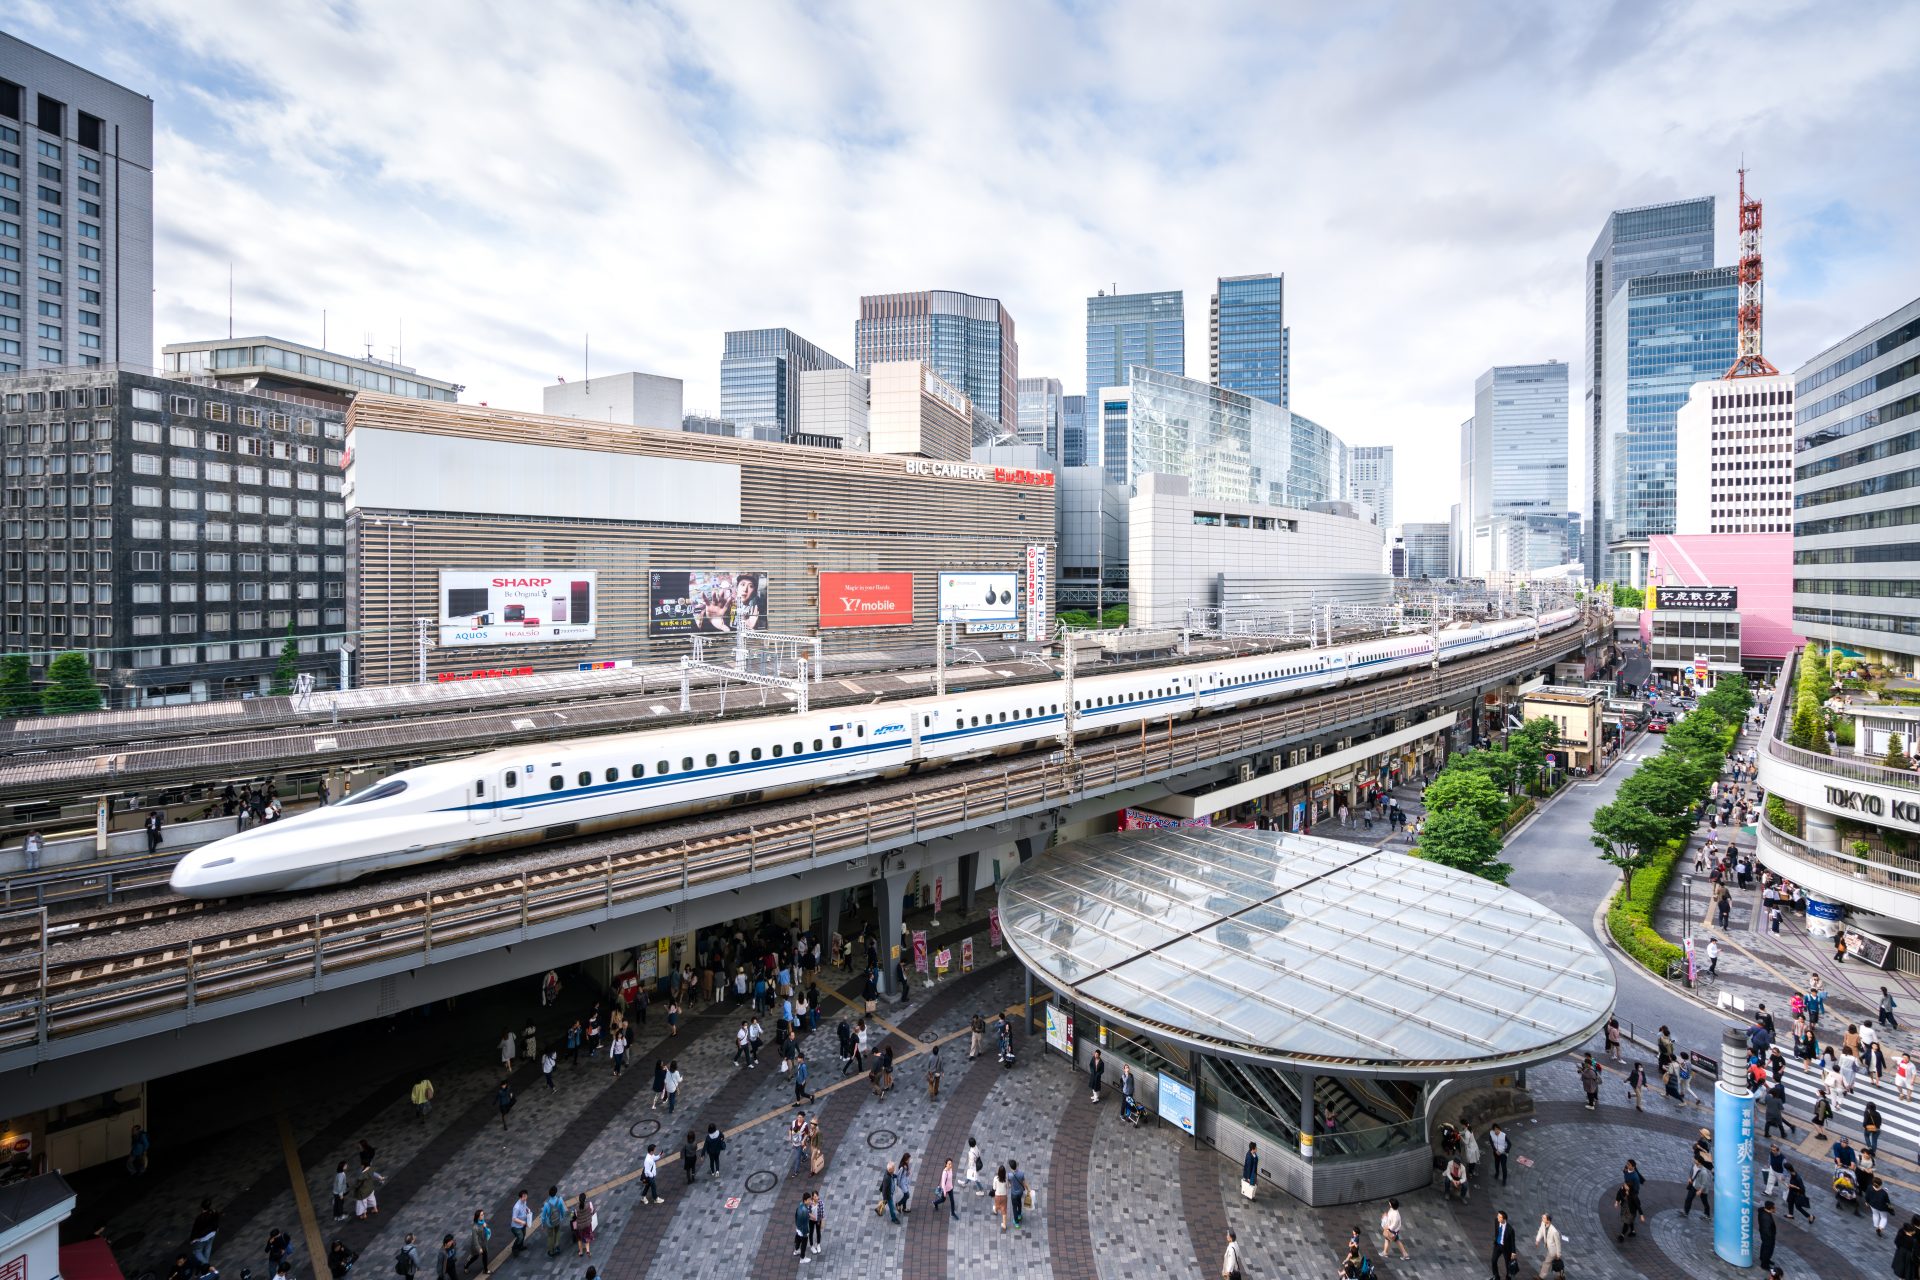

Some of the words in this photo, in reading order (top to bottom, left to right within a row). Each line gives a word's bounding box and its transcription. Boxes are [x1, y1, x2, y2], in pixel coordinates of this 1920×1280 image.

[906, 460, 929, 475] BIC
[932, 463, 986, 480] CAMERA
[1037, 552, 1046, 572] Tax
[492, 578, 552, 587] SHARP
[1037, 574, 1046, 601] Free
[455, 631, 488, 640] AQUOS
[1824, 785, 1883, 816] TOKYO
[1742, 1109, 1751, 1137] 有楽町
[1741, 1165, 1751, 1205] HAPPY
[1740, 1207, 1750, 1256] SQUARE
